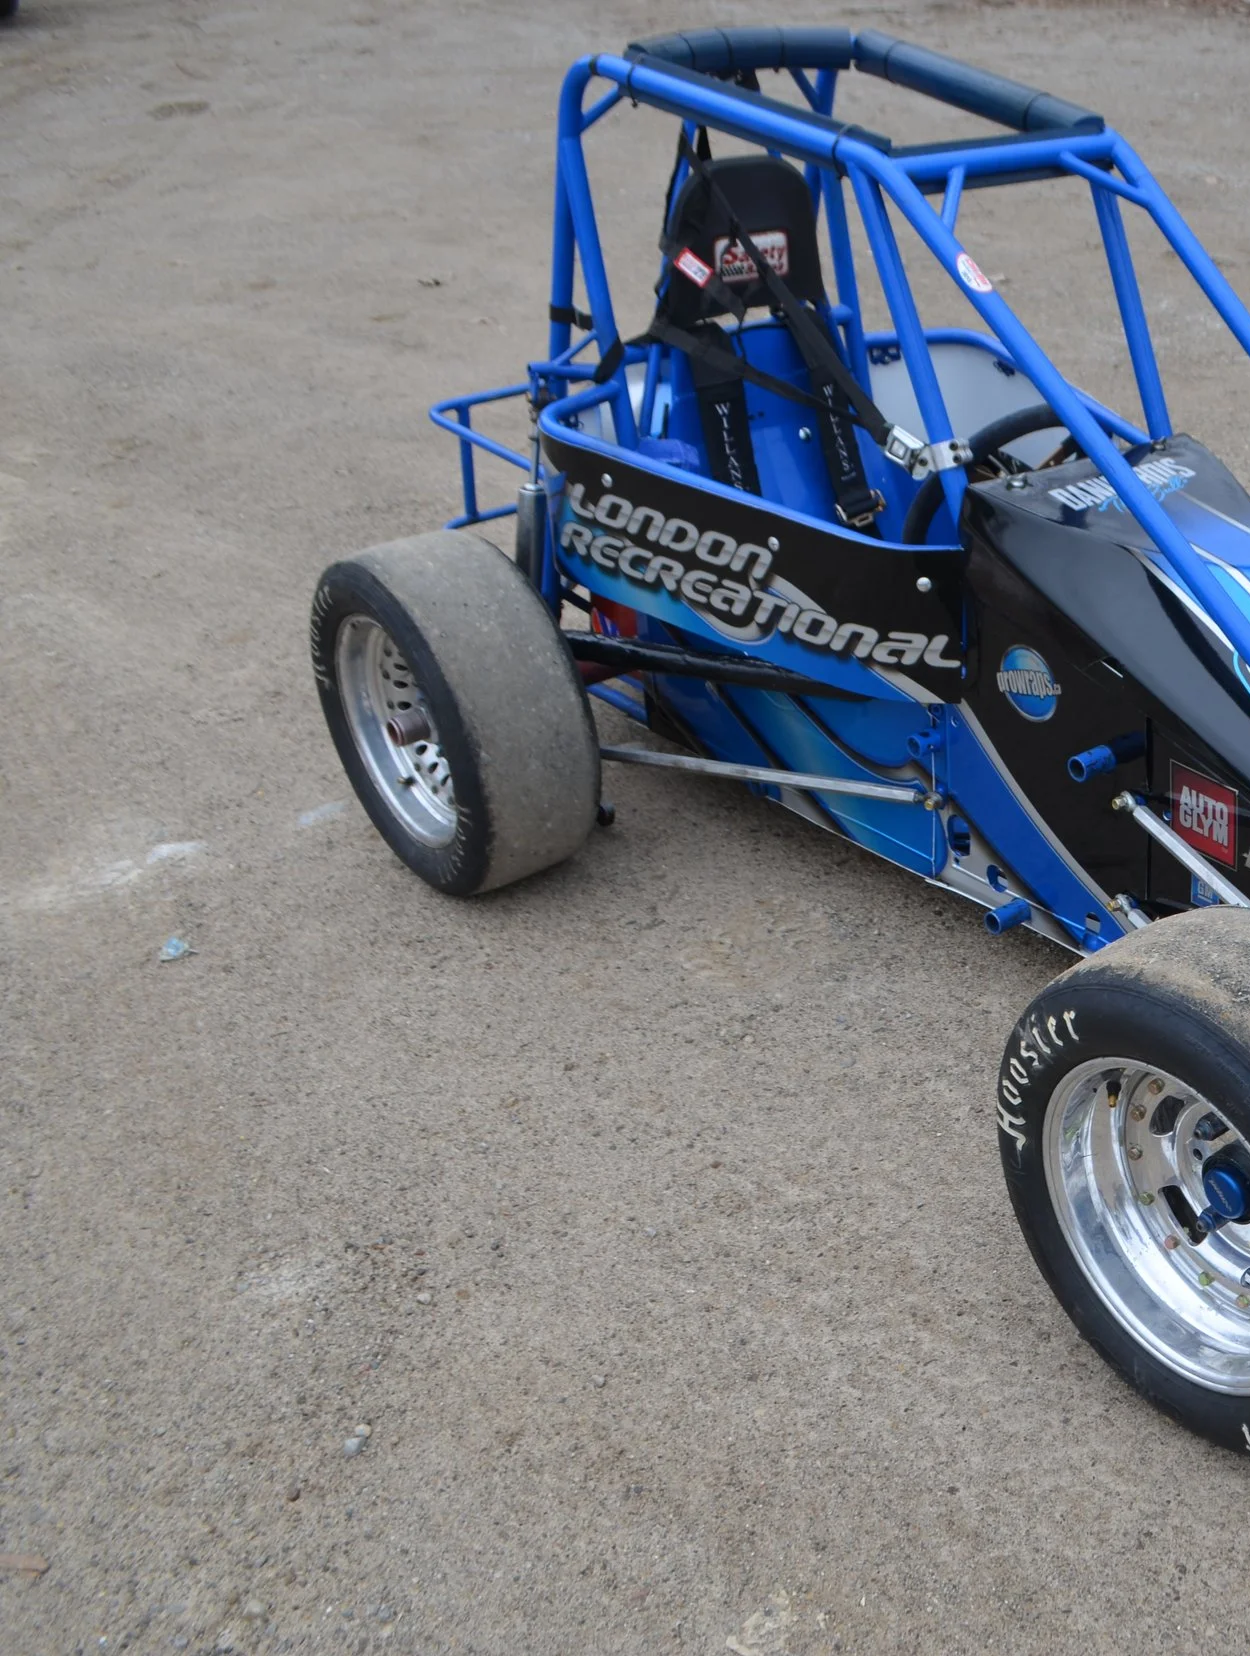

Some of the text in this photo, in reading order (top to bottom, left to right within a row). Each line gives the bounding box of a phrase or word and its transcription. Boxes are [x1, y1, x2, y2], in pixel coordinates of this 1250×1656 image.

[1179, 801, 1228, 847] GLYM
[1180, 785, 1228, 824] AUTO
[997, 1009, 1081, 1150] Hoosier
